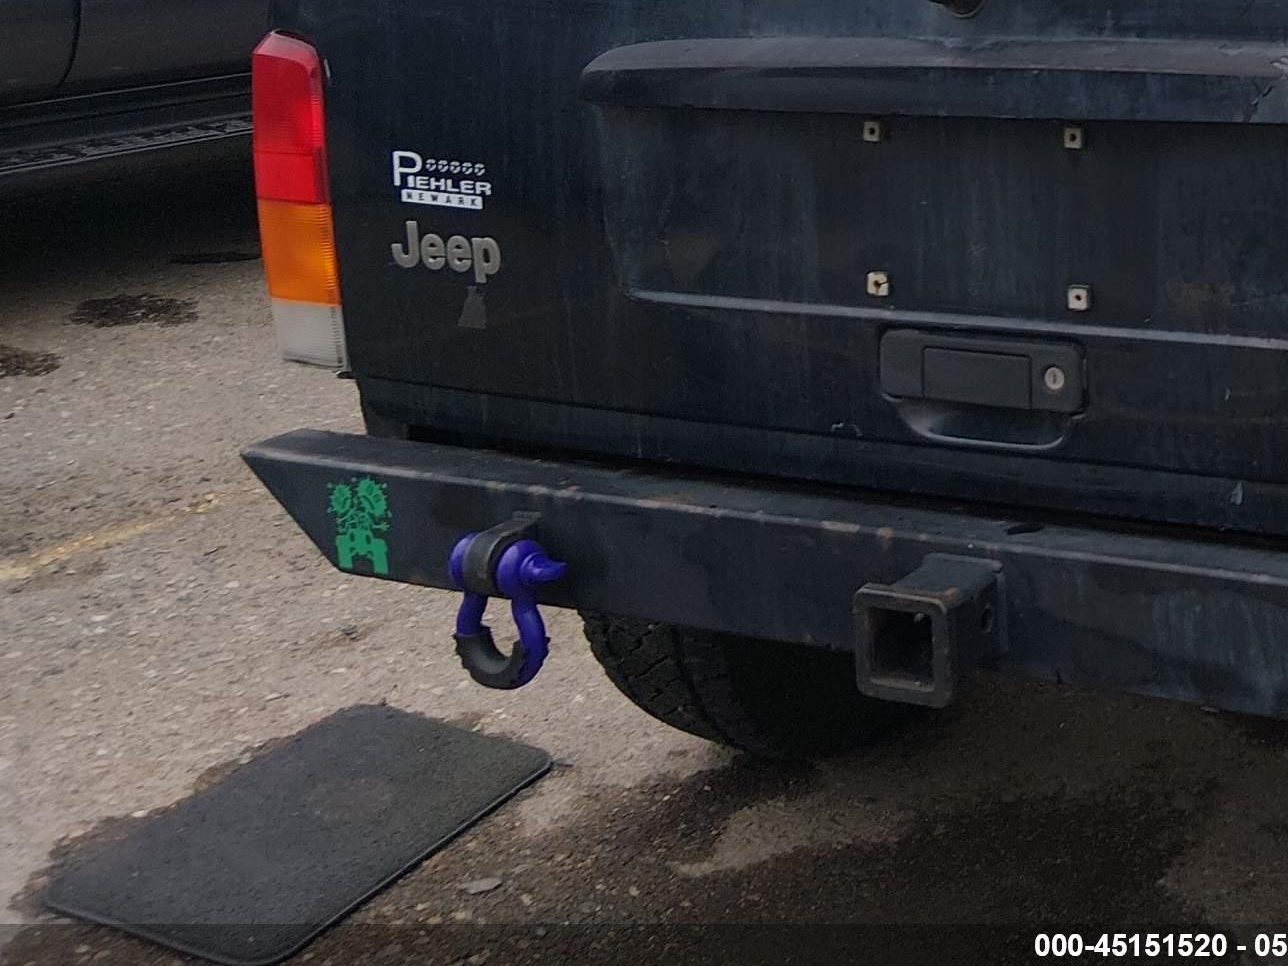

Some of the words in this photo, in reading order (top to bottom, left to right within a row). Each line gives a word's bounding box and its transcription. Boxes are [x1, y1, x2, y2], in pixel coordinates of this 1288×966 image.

[392, 150, 492, 196] PIEHLER
[406, 191, 477, 207] NEWARK
[391, 220, 501, 283] Jeep
